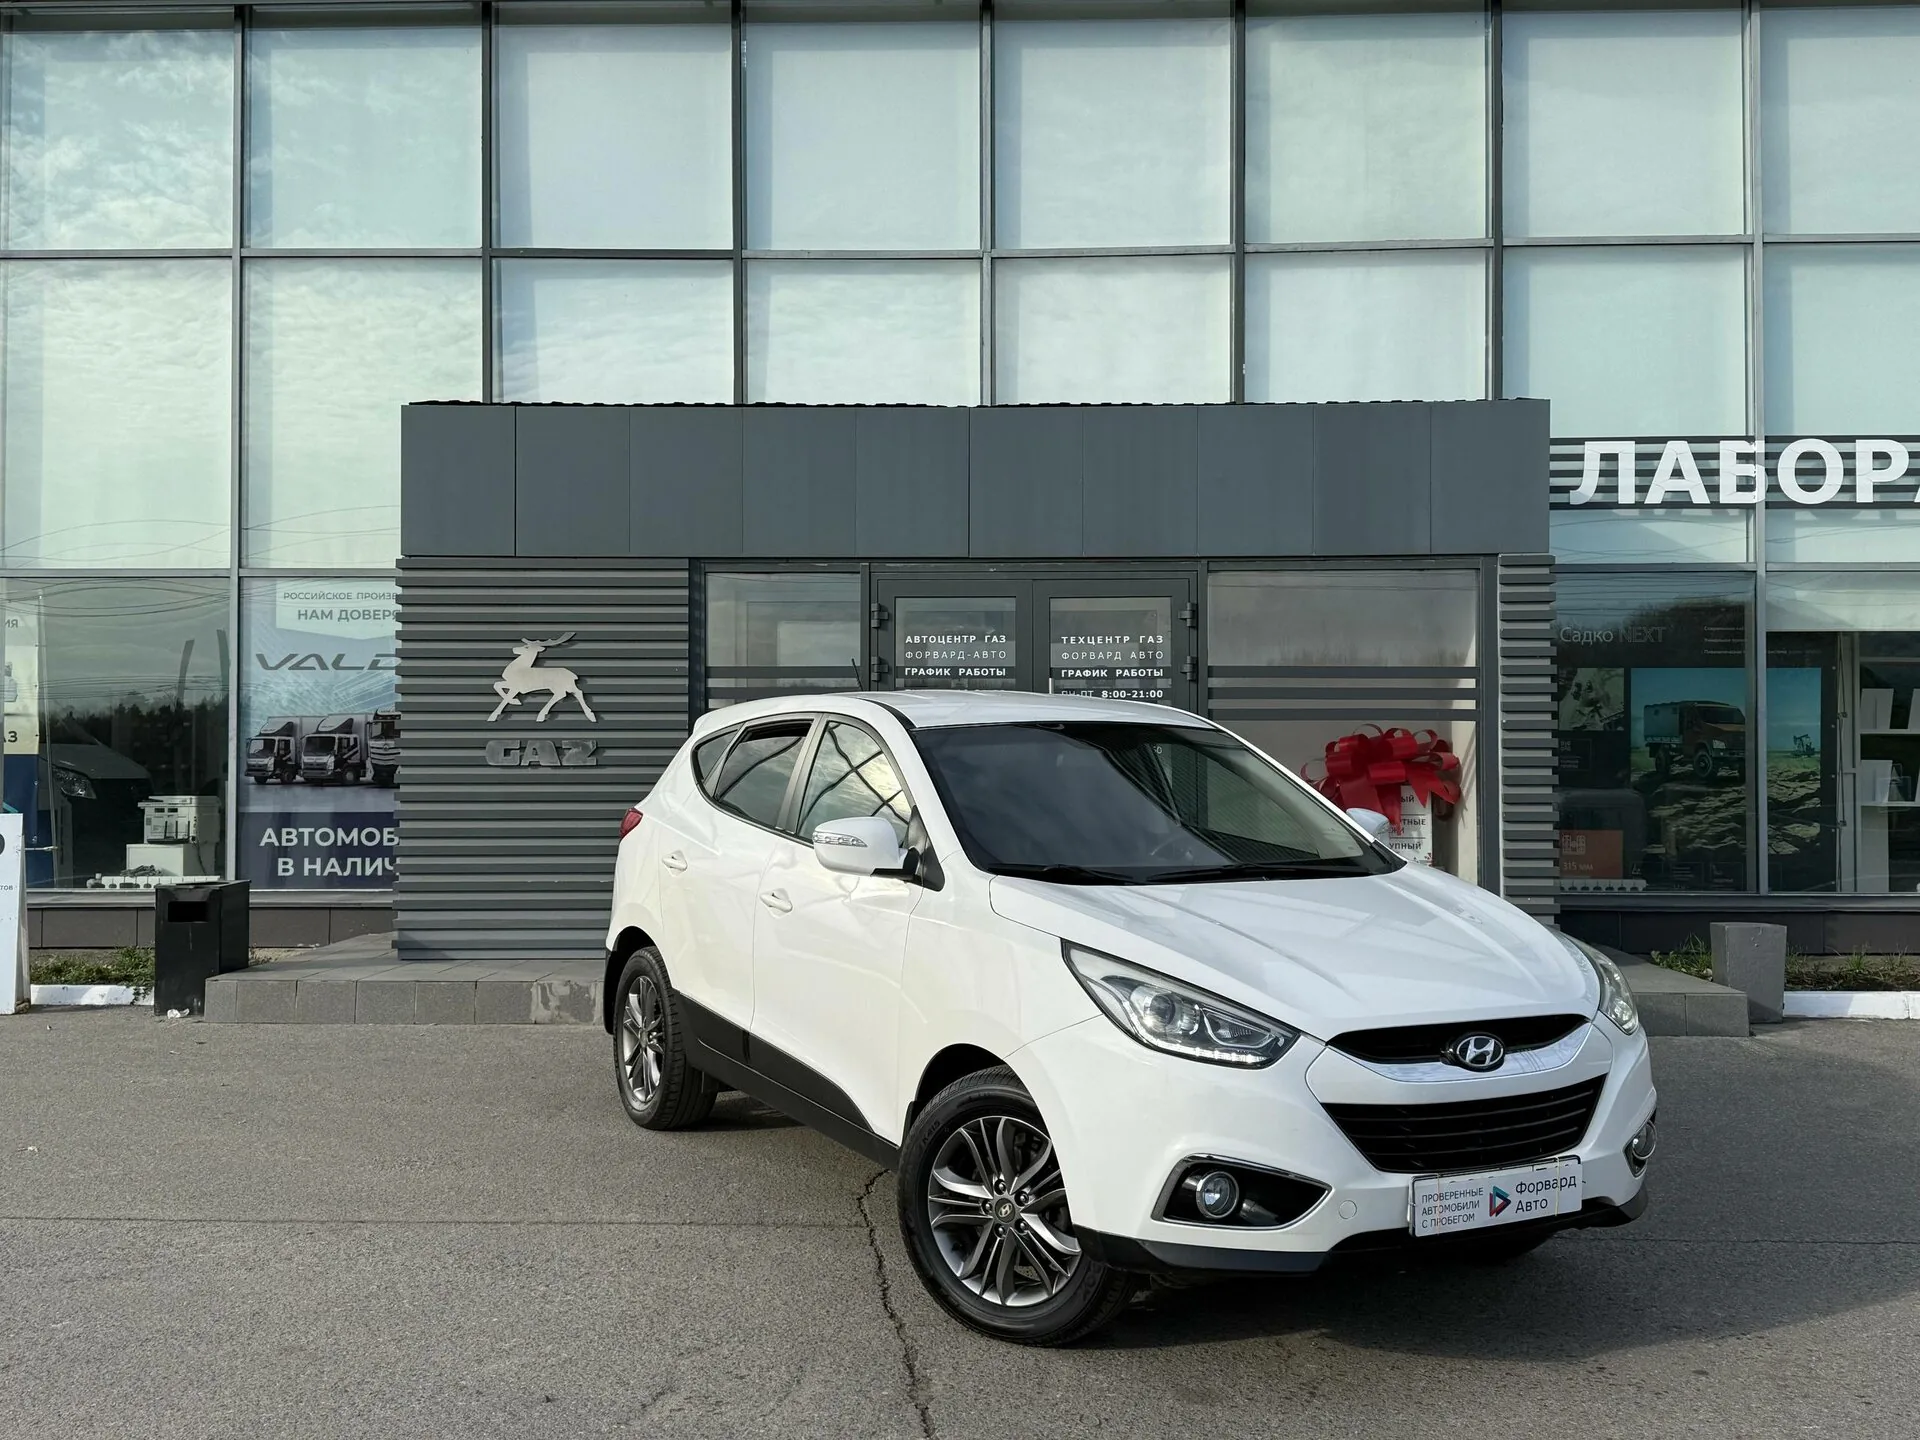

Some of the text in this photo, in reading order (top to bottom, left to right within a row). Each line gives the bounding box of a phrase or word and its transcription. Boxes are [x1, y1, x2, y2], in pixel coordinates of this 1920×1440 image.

[1570, 438, 1920, 505] ЛАБОР
[284, 591, 352, 600] РОССИЙСКОЕ
[298, 609, 333, 620] НАМ
[905, 635, 1006, 645] АВТОЦЕНТР ГАЗ
[1061, 636, 1164, 646] ТЕХЦЕНТР ГАЗ
[1560, 626, 1666, 646] Садко NEXT
[905, 650, 1006, 661] ФОРВАРД-АВТО
[1061, 651, 1164, 661] ФОРВАРД АВТО
[905, 667, 1006, 677] ГРАФИК РАБОТЫ
[1061, 668, 1164, 678] ГРАФИК РАБОТЫ
[1101, 690, 1164, 698] 8:00-21:00
[485, 740, 597, 766] GAZ
[1400, 818, 1426, 826] ТНЫЕ
[259, 827, 400, 847] АВТОМОБ
[277, 857, 295, 876] В
[1515, 1175, 1577, 1195] Форвард
[1421, 1187, 1484, 1204] ПРОВЕРЕННЫЕ
[1421, 1200, 1480, 1216] АВТОМОБИЛИ
[1515, 1197, 1548, 1214] Авто
[1421, 1212, 1475, 1229] С ПРОБЕГОМ
